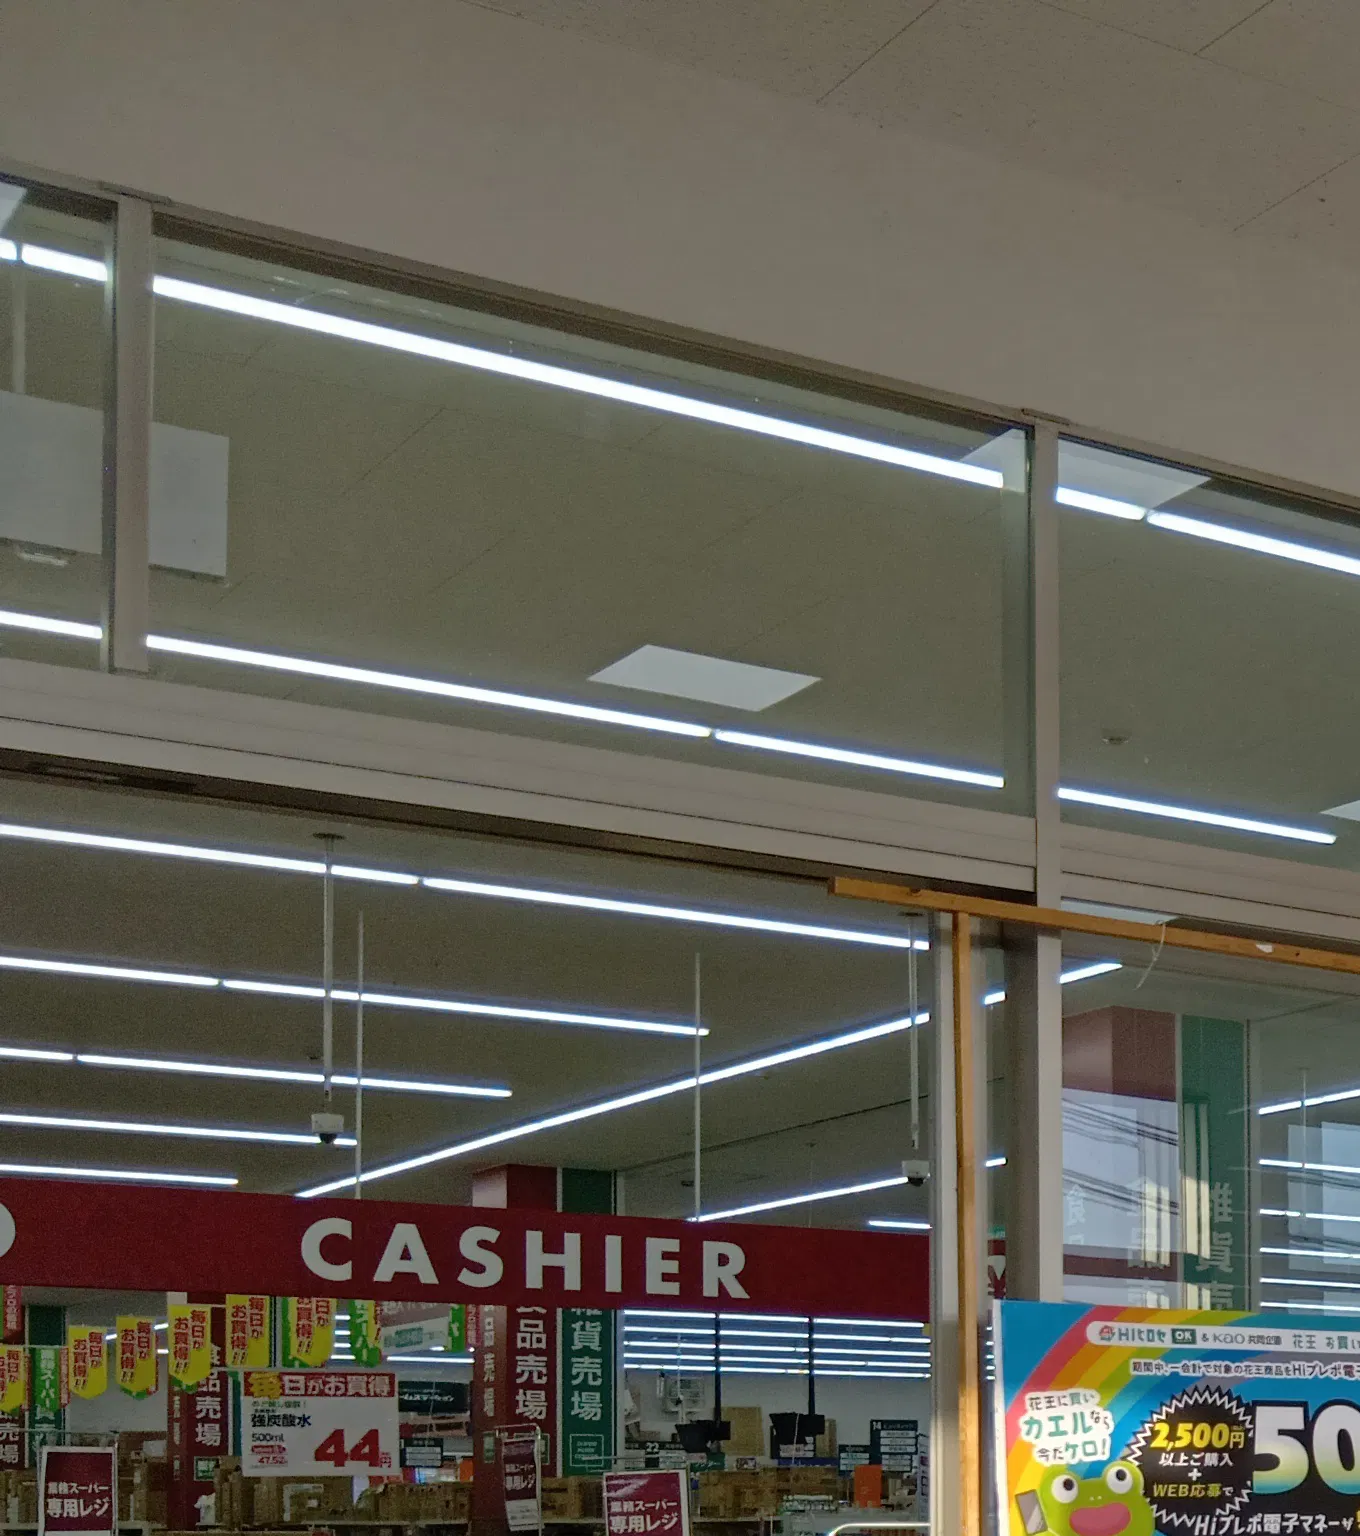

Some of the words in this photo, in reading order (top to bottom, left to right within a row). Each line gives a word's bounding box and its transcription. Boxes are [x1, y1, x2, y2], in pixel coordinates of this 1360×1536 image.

[300, 1219, 750, 1300] CASHIER
[190, 1309, 208, 1350] 毎日が
[249, 1297, 267, 1340] 毎日が
[88, 1331, 104, 1369] 毎日が
[136, 1321, 151, 1360] 毎日が
[1293, 1333, 1317, 1349] 花王
[515, 1306, 549, 1421] 品売場
[248, 1371, 395, 1399] 毎日がお買得
[1029, 1391, 1097, 1411] 花王に買い
[251, 1413, 312, 1429] 強炭酸水
[1022, 1408, 1112, 1439] カエルなら
[251, 1432, 285, 1444] 500ml
[1151, 1422, 1245, 1451] 2,500円
[1158, 1451, 1234, 1468] 以上ご購入
[47, 1481, 110, 1495] 業務スーパー
[1152, 1482, 1233, 1498] WEB応募で
[46, 1497, 110, 1519] 専用レジ
[609, 1499, 679, 1514] 業務スーパー
[609, 1511, 680, 1536] 専用レジ
